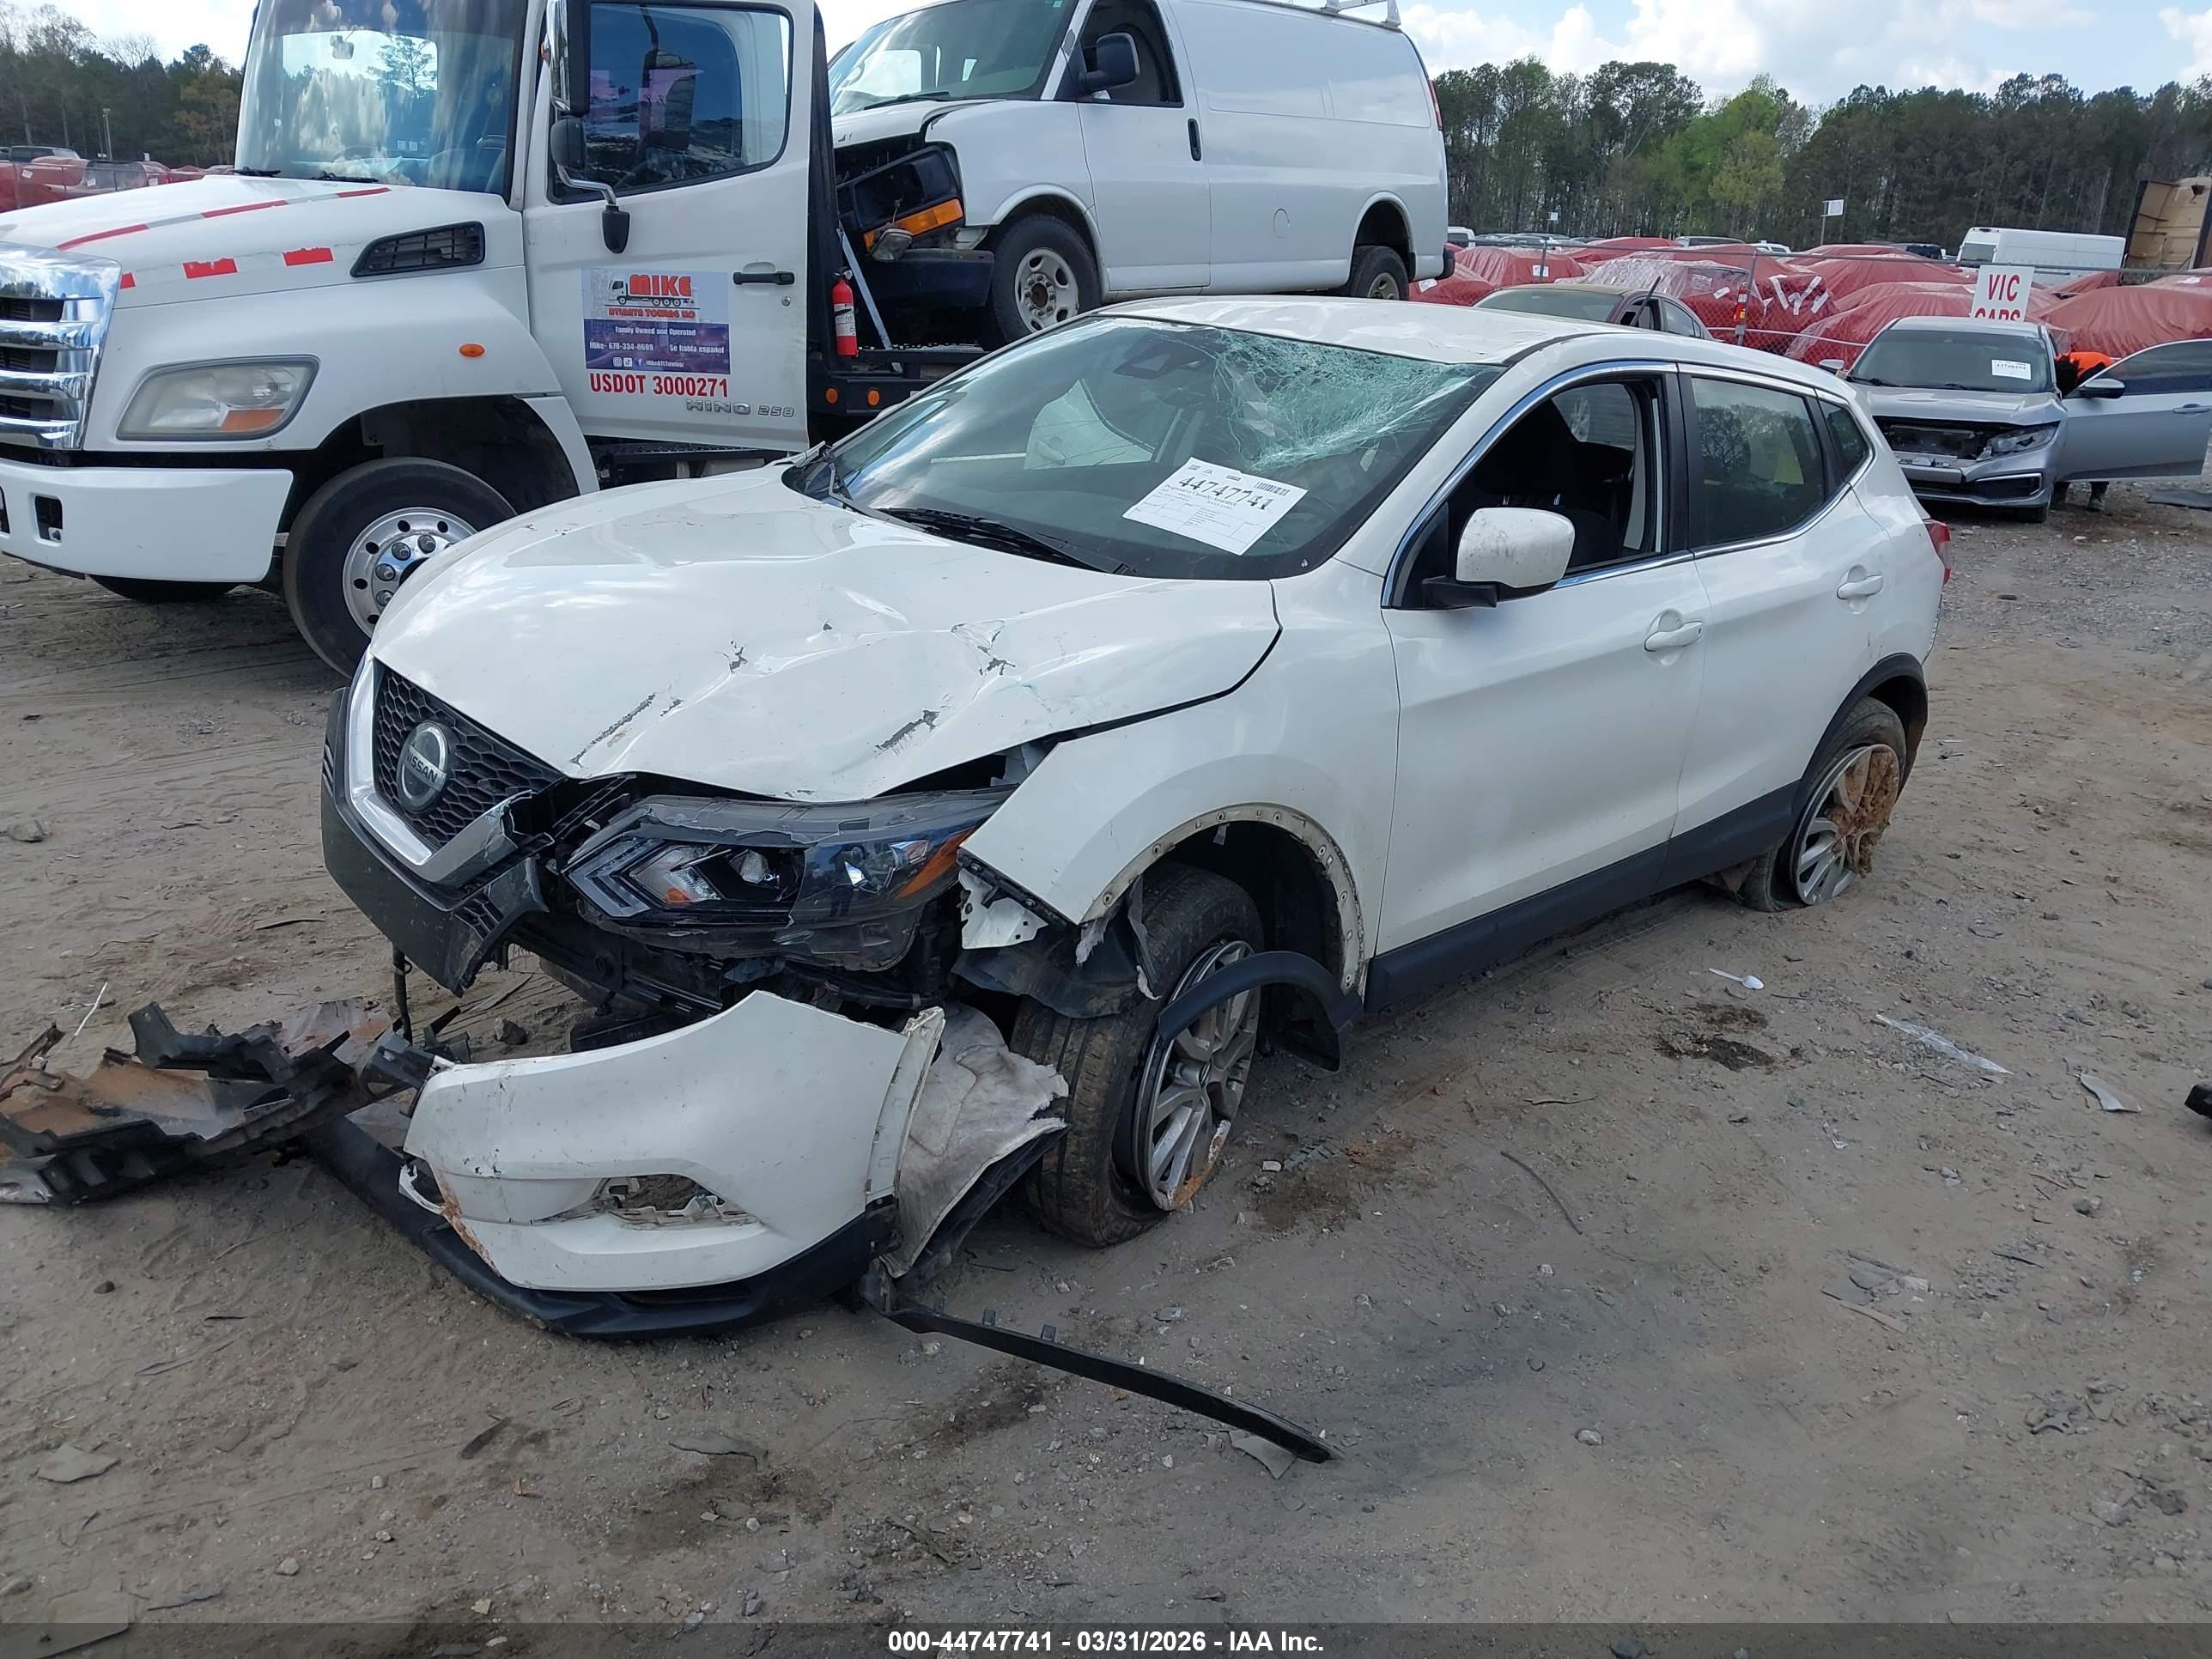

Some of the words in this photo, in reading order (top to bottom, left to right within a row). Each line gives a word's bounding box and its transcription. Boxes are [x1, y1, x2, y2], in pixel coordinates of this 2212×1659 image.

[629, 274, 691, 297] MIKE
[1987, 274, 2021, 301] VIC
[615, 326, 634, 335] Family
[679, 344, 697, 353] habla
[590, 373, 646, 394] USDOT
[653, 375, 729, 398] 3000271
[686, 399, 751, 415] HINO
[757, 405, 795, 418] 258
[1179, 476, 1273, 510] 44747741
[407, 748, 439, 784] NISSAN
